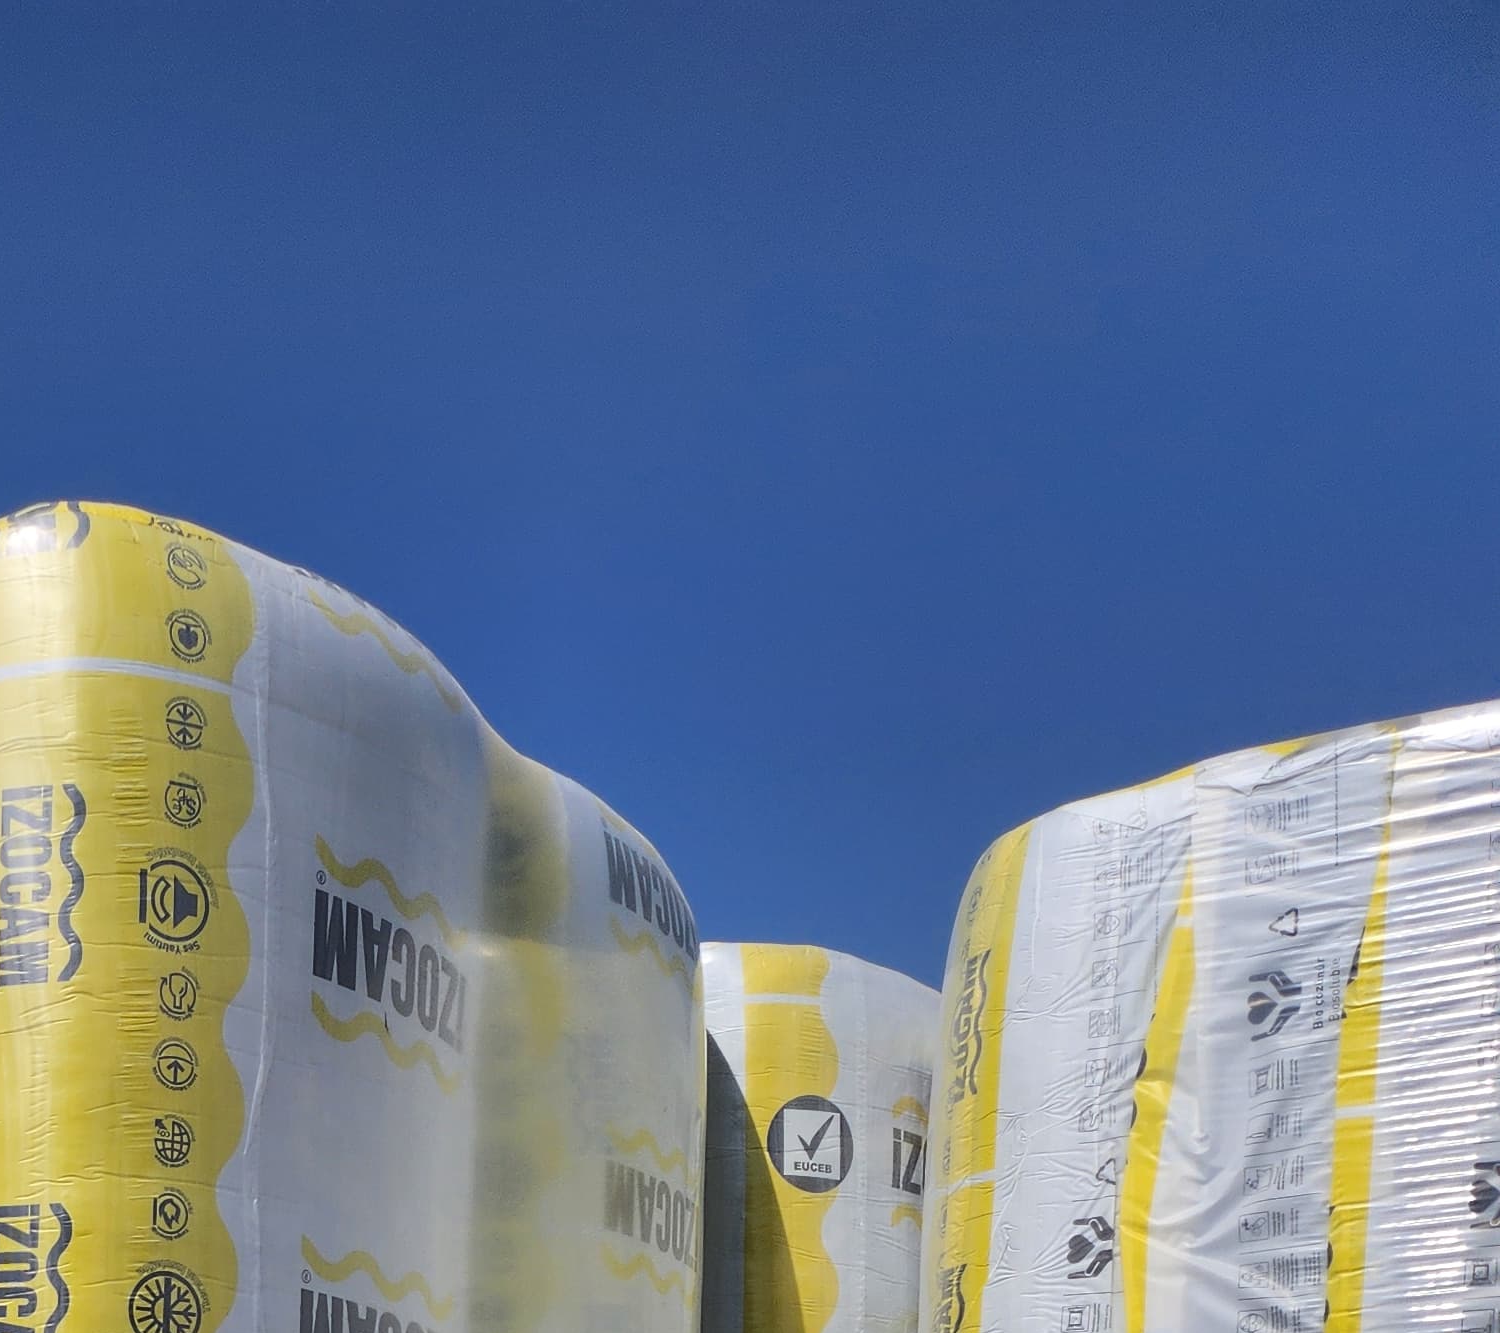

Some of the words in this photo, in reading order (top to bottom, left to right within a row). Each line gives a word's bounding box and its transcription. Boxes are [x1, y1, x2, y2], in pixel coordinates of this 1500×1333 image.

[144, 932, 182, 954] Yalıtımı
[184, 940, 200, 952] Ses
[794, 1161, 832, 1173] EUCEB
